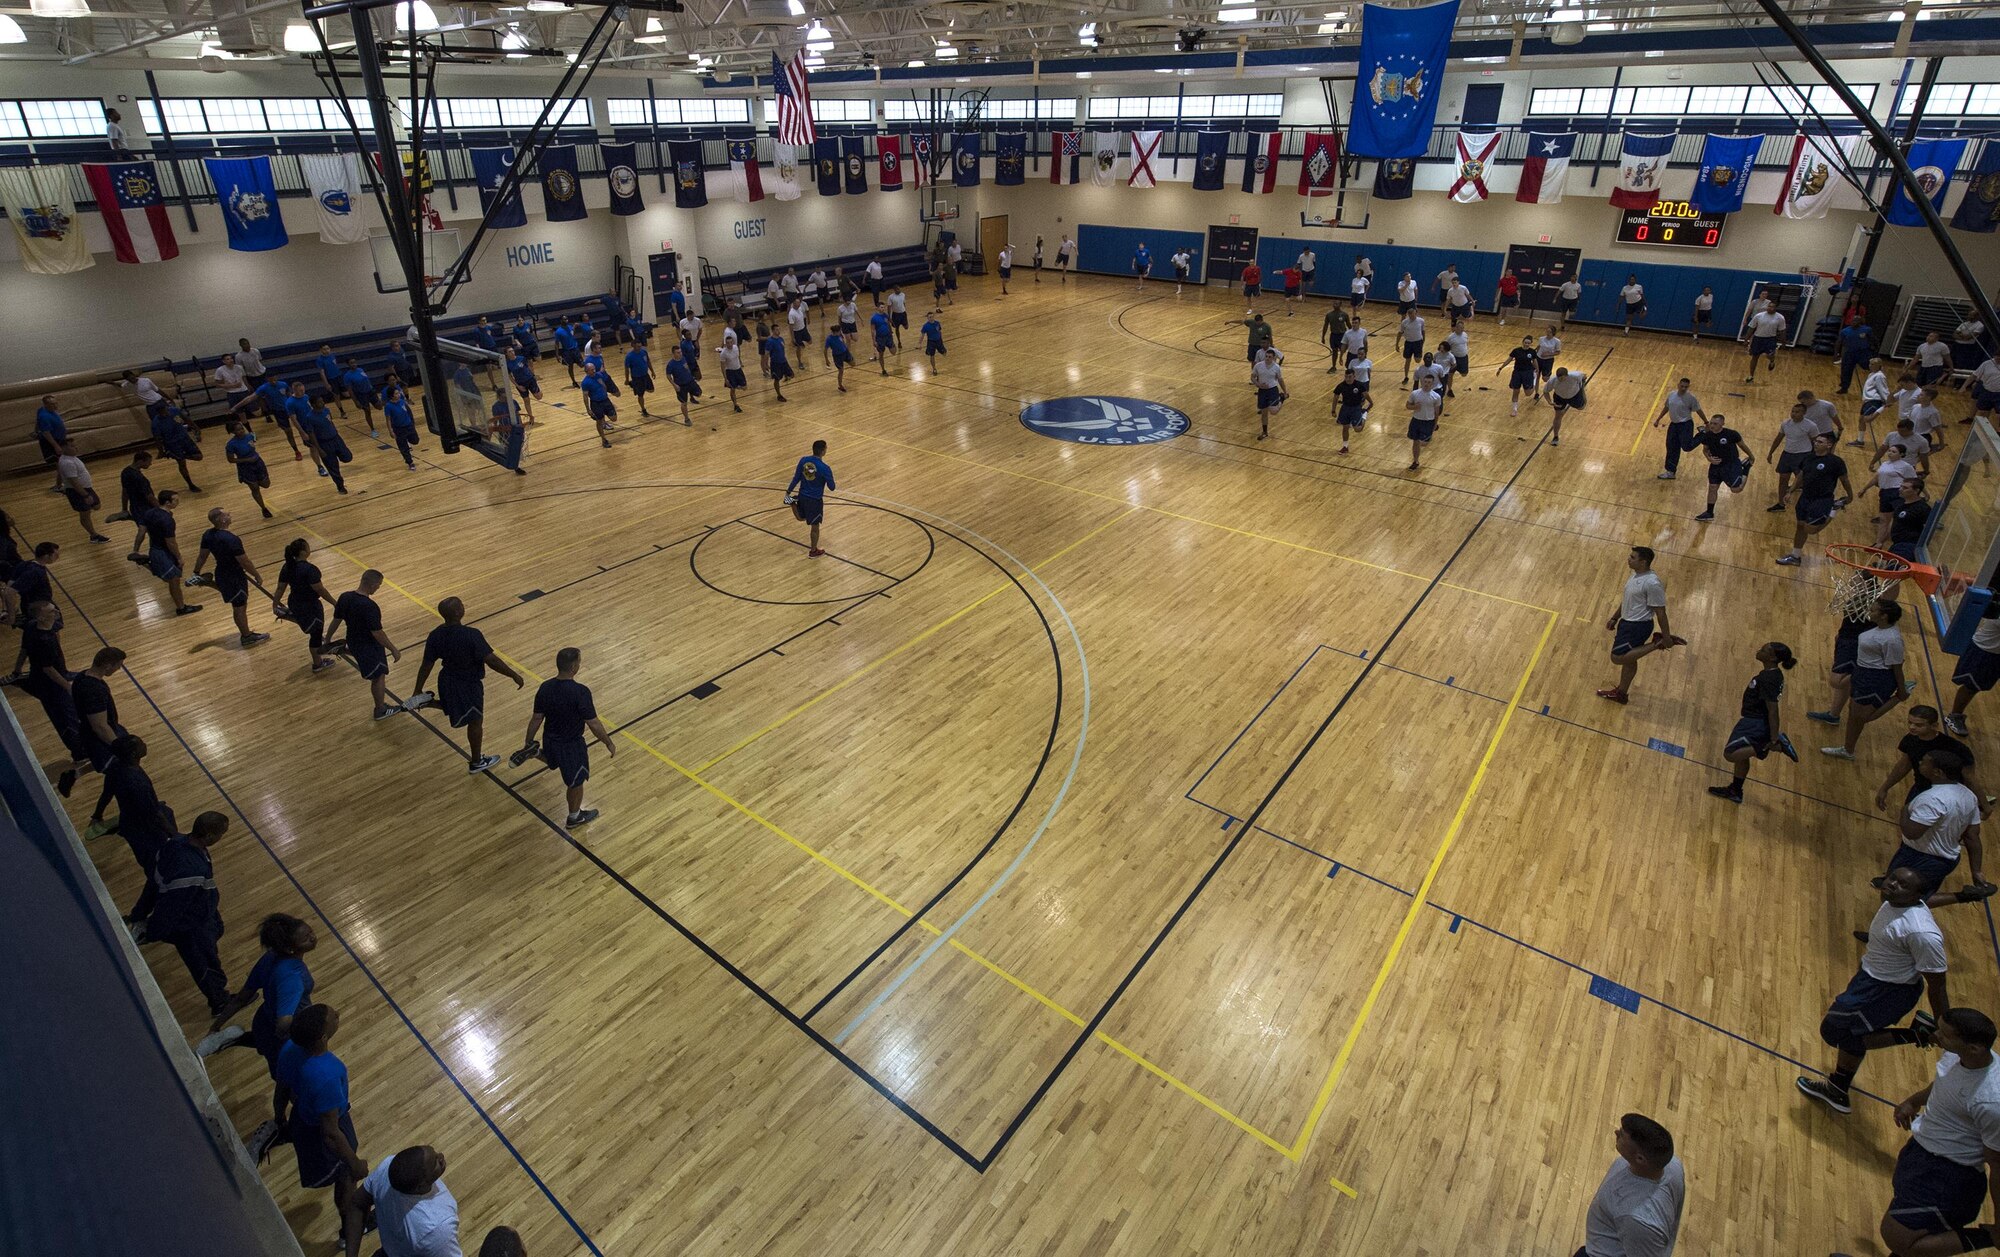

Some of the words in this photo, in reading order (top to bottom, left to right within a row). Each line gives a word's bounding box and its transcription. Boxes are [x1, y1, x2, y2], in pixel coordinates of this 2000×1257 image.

[1735, 154, 1754, 196] WISCONSIN
[1627, 217, 1649, 225] HOME
[1694, 220, 1720, 229] GUEST
[734, 218, 767, 240] GUEST
[1637, 226, 1648, 240] 0
[1664, 229, 1673, 240] 0
[1705, 230, 1718, 244] 0
[506, 242, 555, 268] HOME
[1145, 403, 1187, 432] FORCE
[1078, 435, 1132, 445] U.S.
[1136, 430, 1174, 443] AIR
